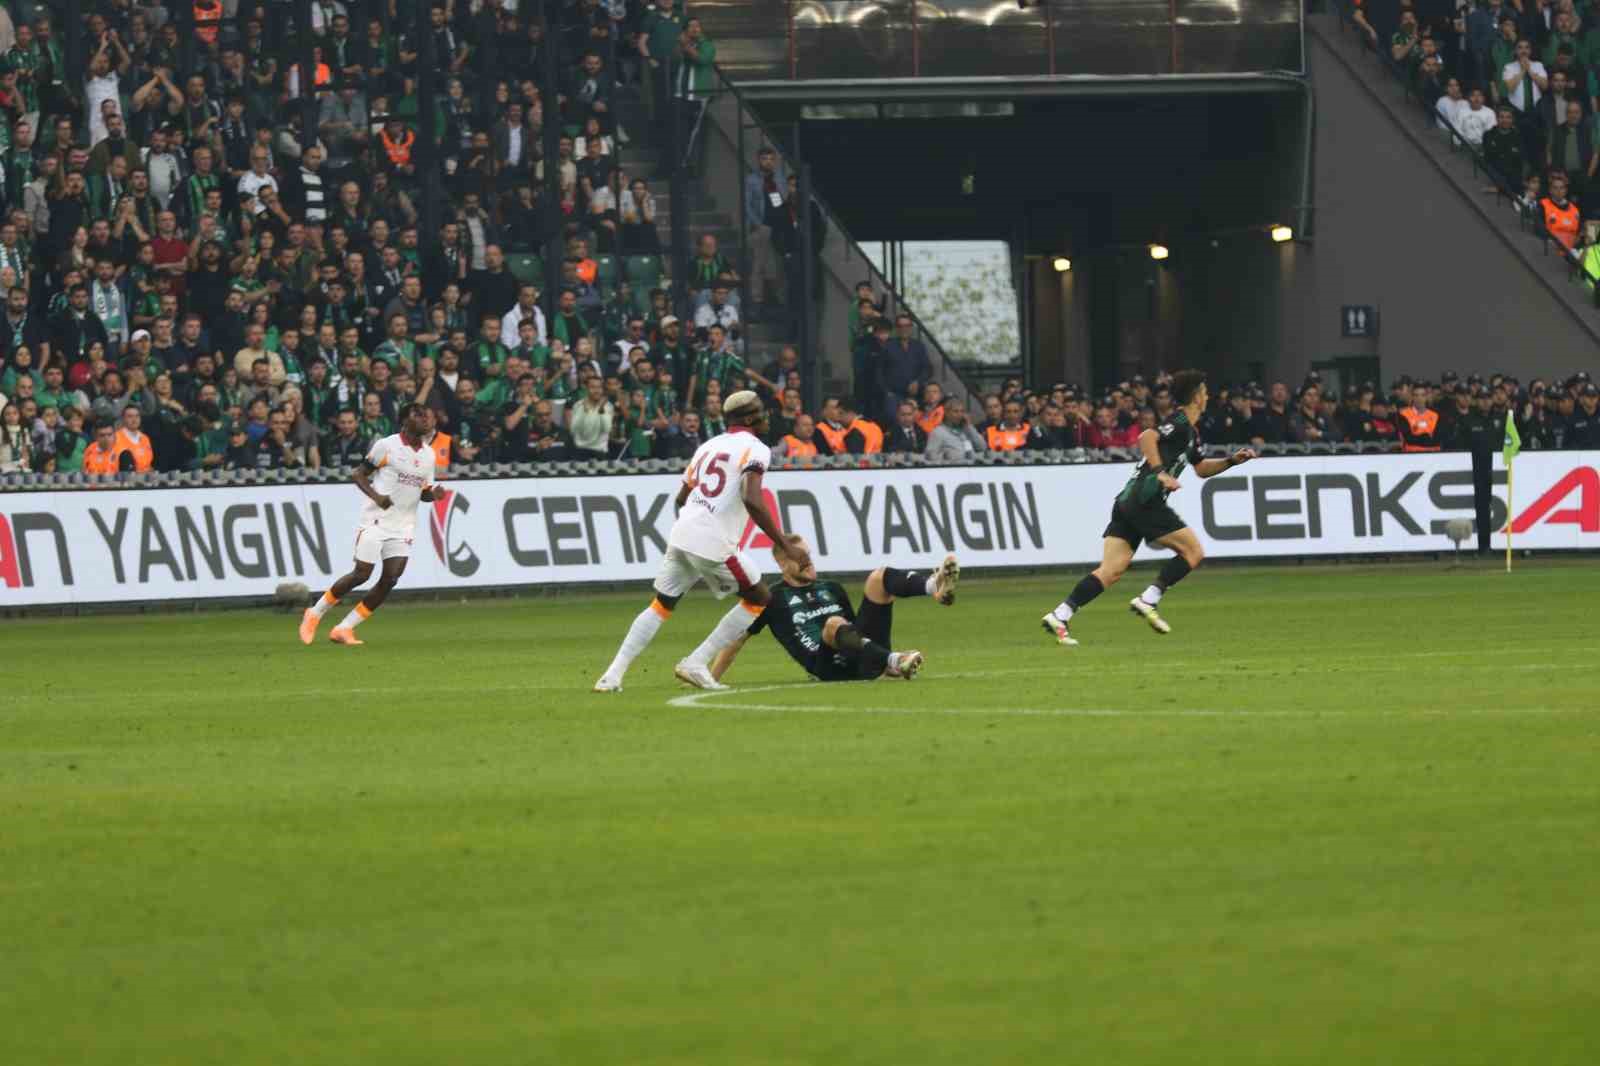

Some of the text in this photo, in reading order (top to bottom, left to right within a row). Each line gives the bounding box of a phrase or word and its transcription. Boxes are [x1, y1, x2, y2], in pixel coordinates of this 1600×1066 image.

[88, 501, 332, 584] YANGIN
[502, 481, 1044, 567] CENKAN YANGIN
